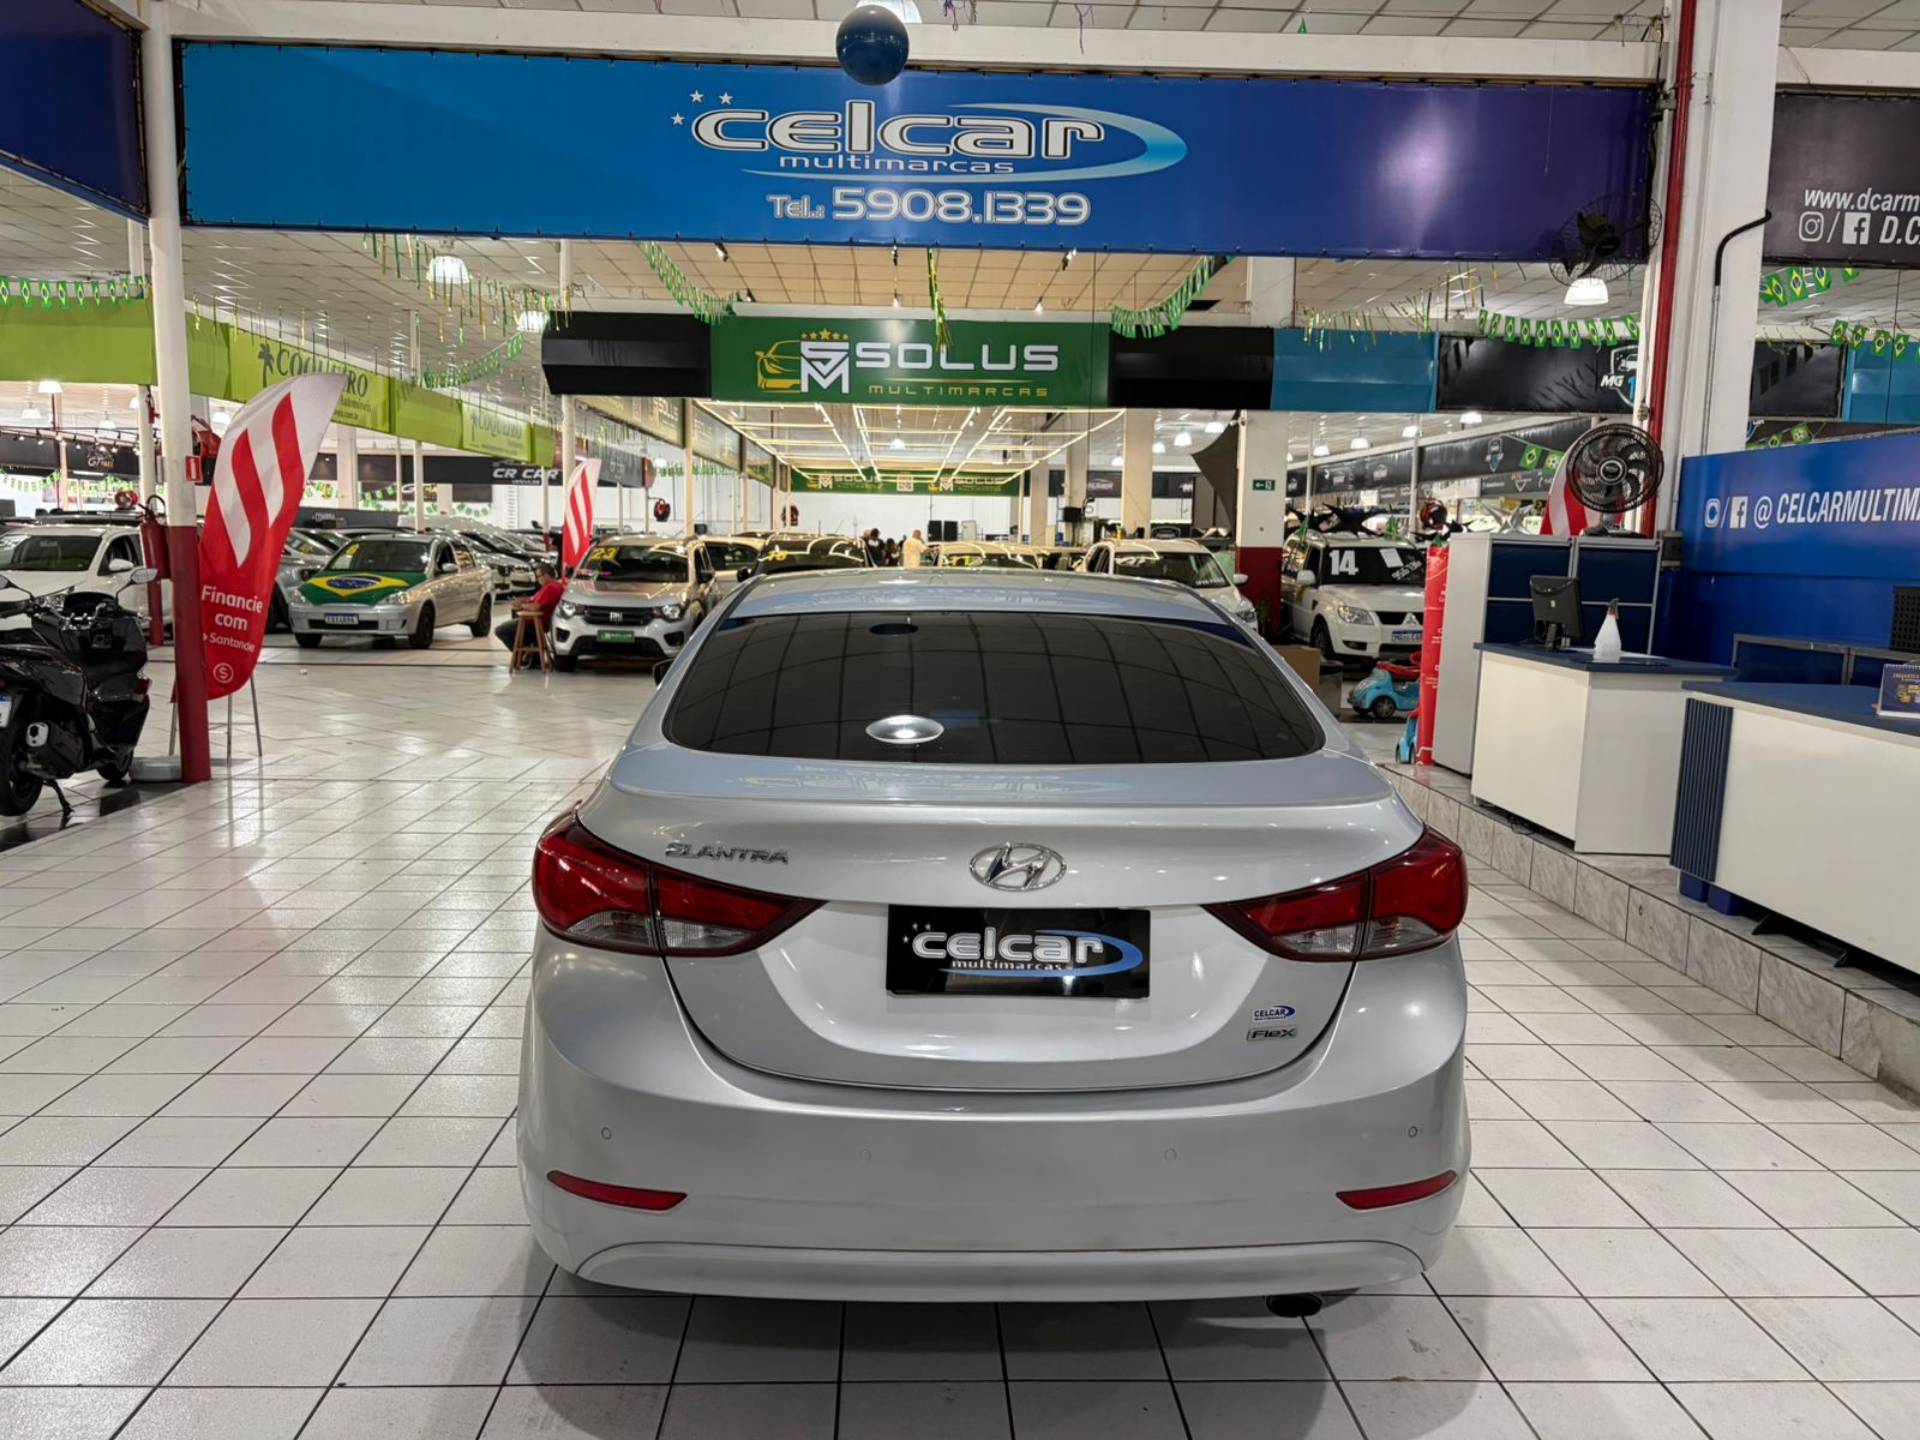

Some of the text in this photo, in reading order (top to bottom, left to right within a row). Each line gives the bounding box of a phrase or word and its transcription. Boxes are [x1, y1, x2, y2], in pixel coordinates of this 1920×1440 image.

[691, 100, 1104, 160] celcar
[779, 155, 1015, 174] multimarcas
[832, 186, 1091, 226] 5908.1339
[855, 342, 1059, 371] SOLUS
[868, 384, 1049, 397] MULTIMARCAS
[1600, 374, 1625, 388] MG
[492, 468, 518, 479] CR
[1329, 550, 1359, 575] 14
[201, 585, 263, 613] Financie
[215, 613, 247, 631] com
[664, 842, 788, 864] ELANTRA
[912, 926, 1103, 964] celcar
[952, 960, 1061, 971] multimarcas
[1254, 1008, 1286, 1017] CELCAR
